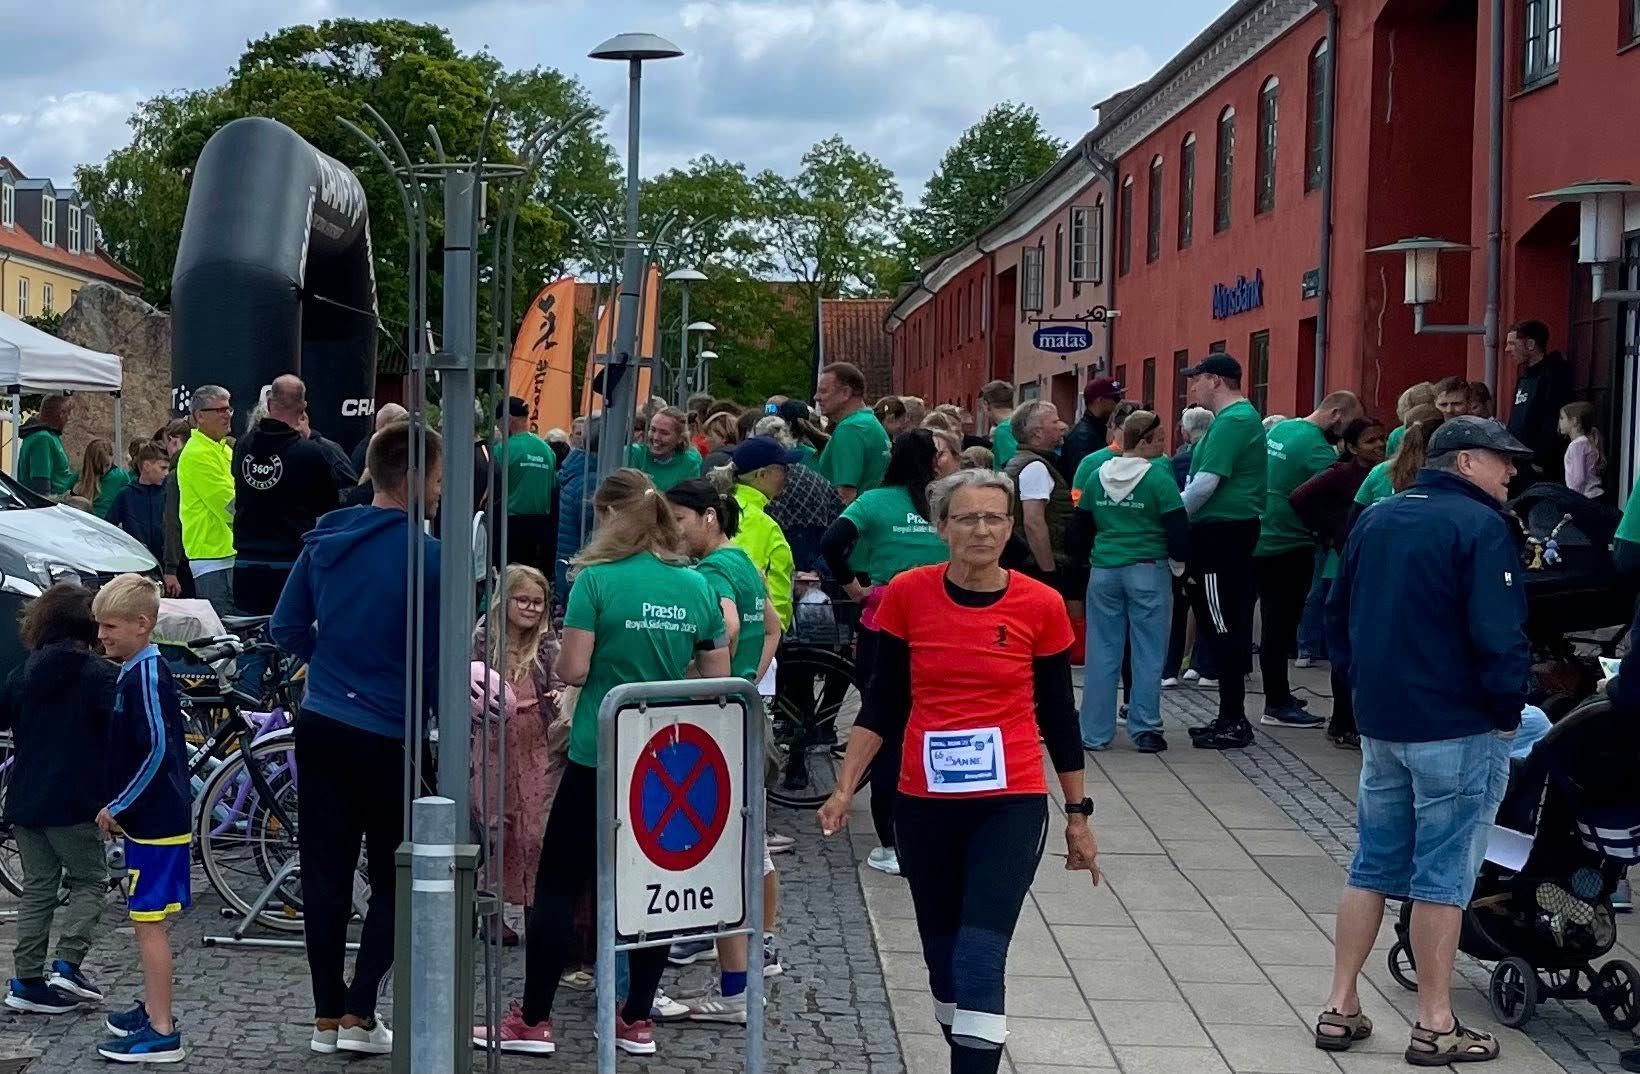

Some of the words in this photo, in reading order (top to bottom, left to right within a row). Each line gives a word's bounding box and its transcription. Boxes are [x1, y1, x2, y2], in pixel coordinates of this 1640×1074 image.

[1039, 331, 1087, 348] matas
[642, 602, 687, 620] Præstø
[646, 883, 714, 915] Zone
